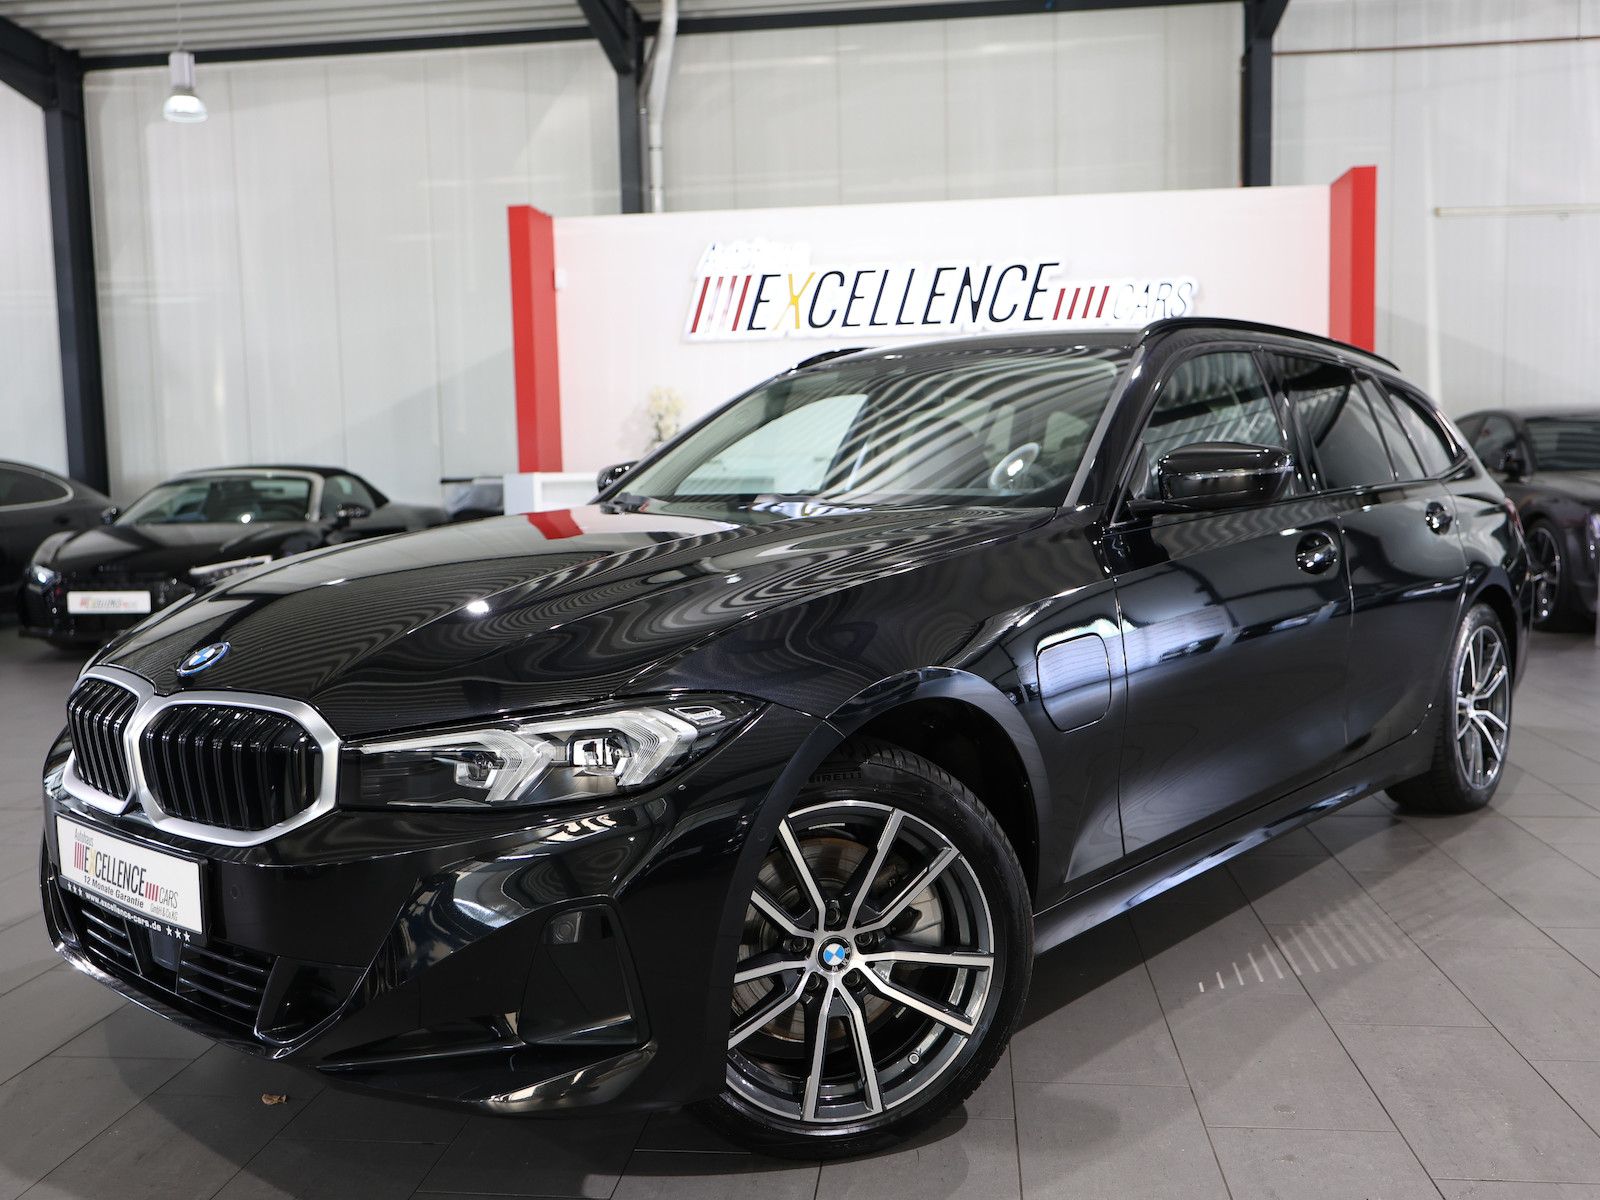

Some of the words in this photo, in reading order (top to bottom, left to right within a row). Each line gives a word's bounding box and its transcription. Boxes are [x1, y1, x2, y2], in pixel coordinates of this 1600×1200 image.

[747, 262, 1059, 331] EXCELLENCE
[1112, 281, 1193, 320] CARS
[84, 846, 147, 897] EXCELLENCE
[159, 886, 179, 909] CARS
[84, 875, 91, 884] 12
[92, 878, 114, 895] Monate
[115, 889, 144, 909] Garantie
[85, 891, 162, 932] www.excellence-cars.de
